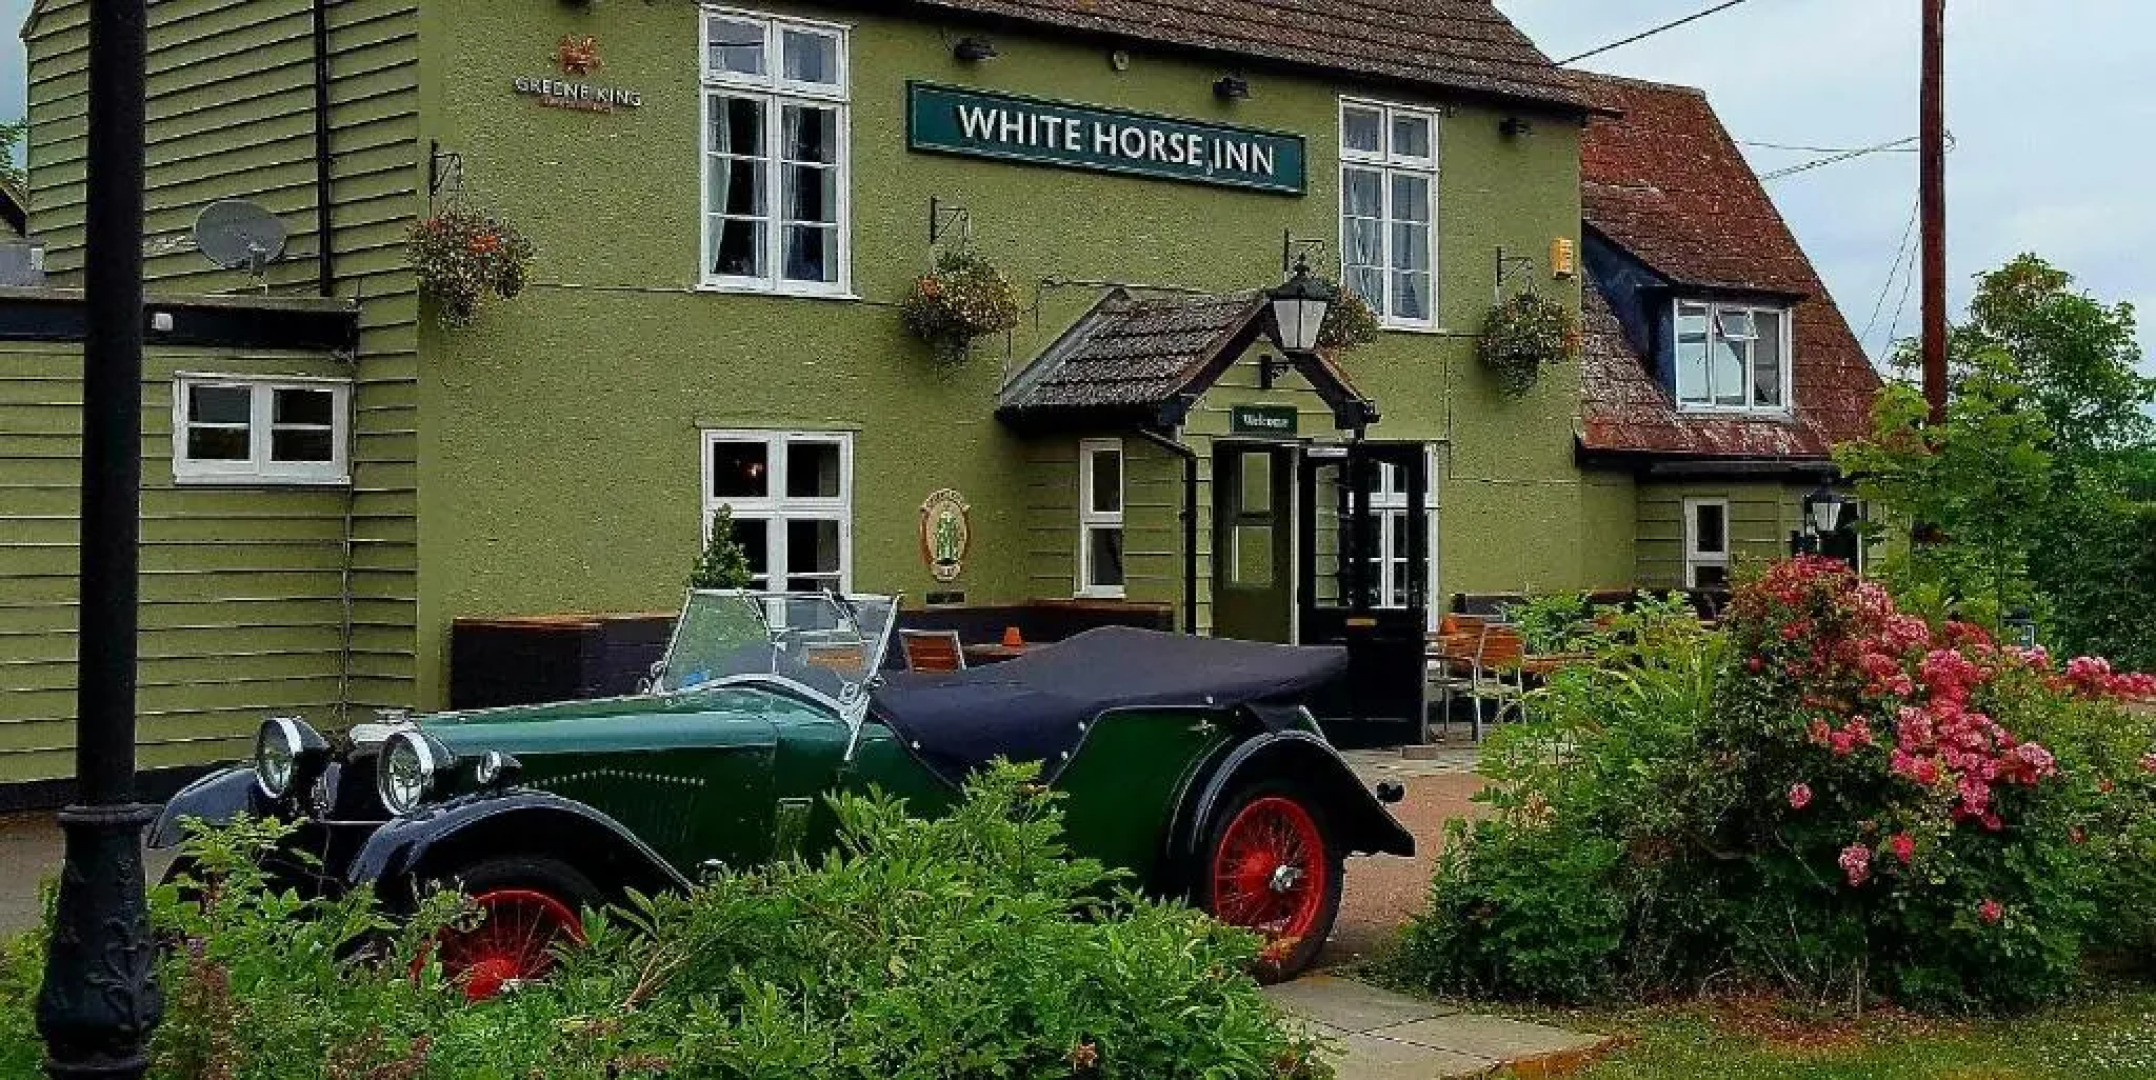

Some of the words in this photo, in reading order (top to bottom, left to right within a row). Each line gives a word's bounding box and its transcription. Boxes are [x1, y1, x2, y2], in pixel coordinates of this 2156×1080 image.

[514, 76, 589, 102] GREENE
[597, 87, 641, 107] KING
[958, 103, 1081, 152] WHITE
[1213, 137, 1274, 176] INN
